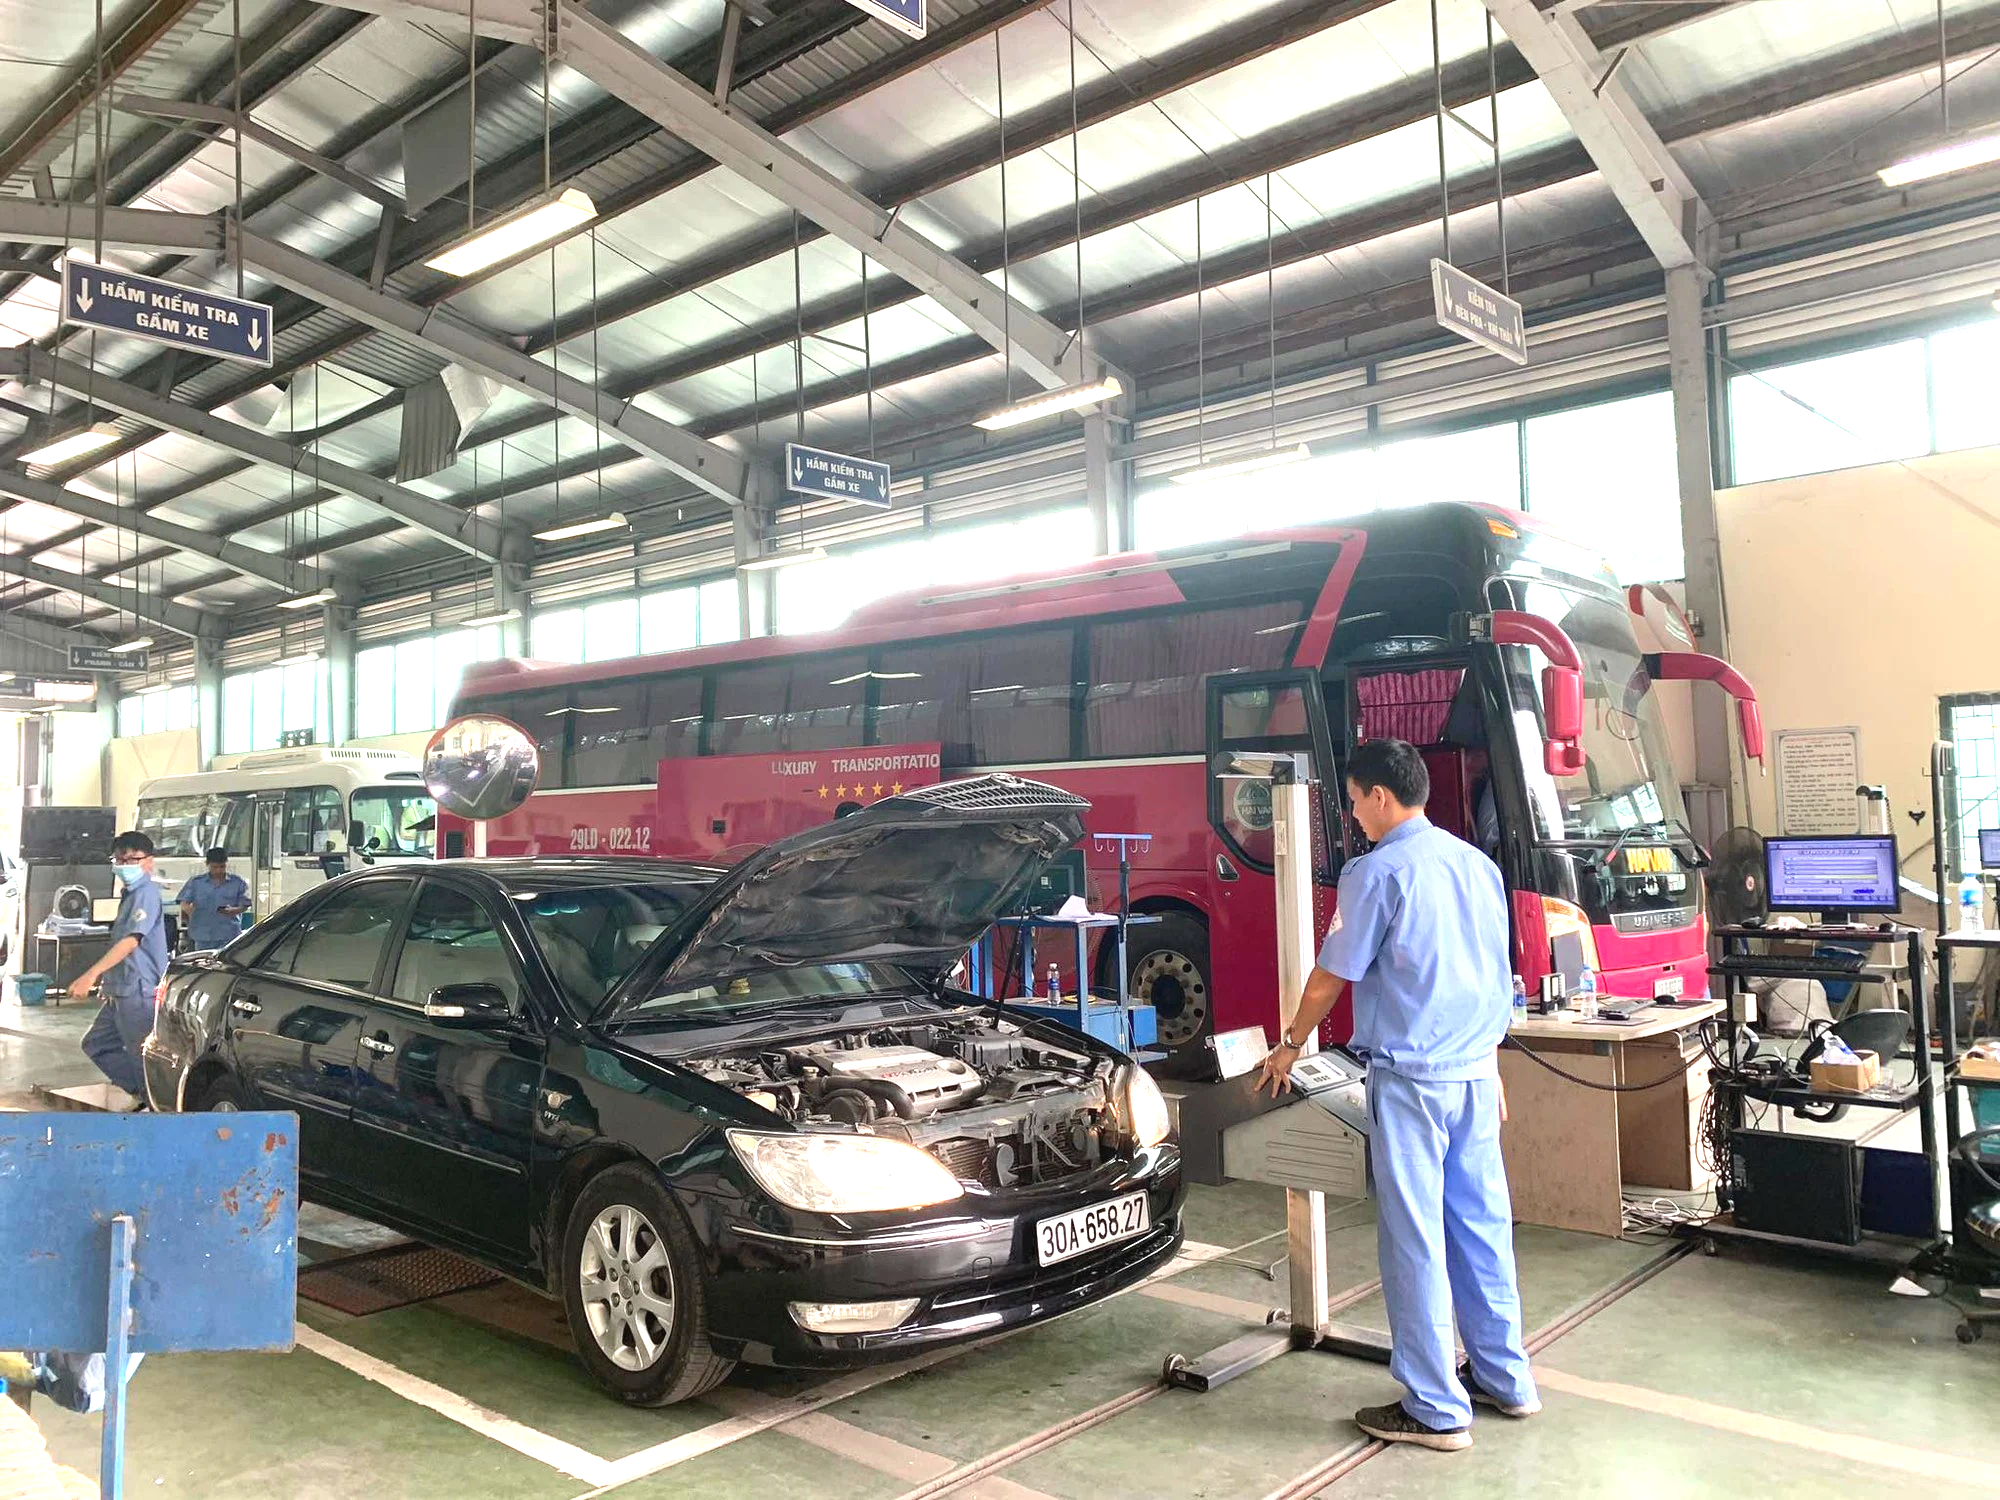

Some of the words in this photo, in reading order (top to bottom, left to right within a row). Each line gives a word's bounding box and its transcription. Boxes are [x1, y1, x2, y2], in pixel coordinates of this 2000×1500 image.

[151, 292, 200, 317] KIỂM
[204, 305, 240, 326] TRA
[185, 323, 209, 341] XE
[856, 468, 875, 482] TRA
[847, 482, 860, 493] XE
[771, 760, 818, 776] LUXURY
[831, 753, 941, 773] TRANSPORTATIO
[569, 827, 598, 850] 29LD
[609, 826, 651, 850] 022.12
[1042, 1196, 1144, 1258] 30A-658.27
